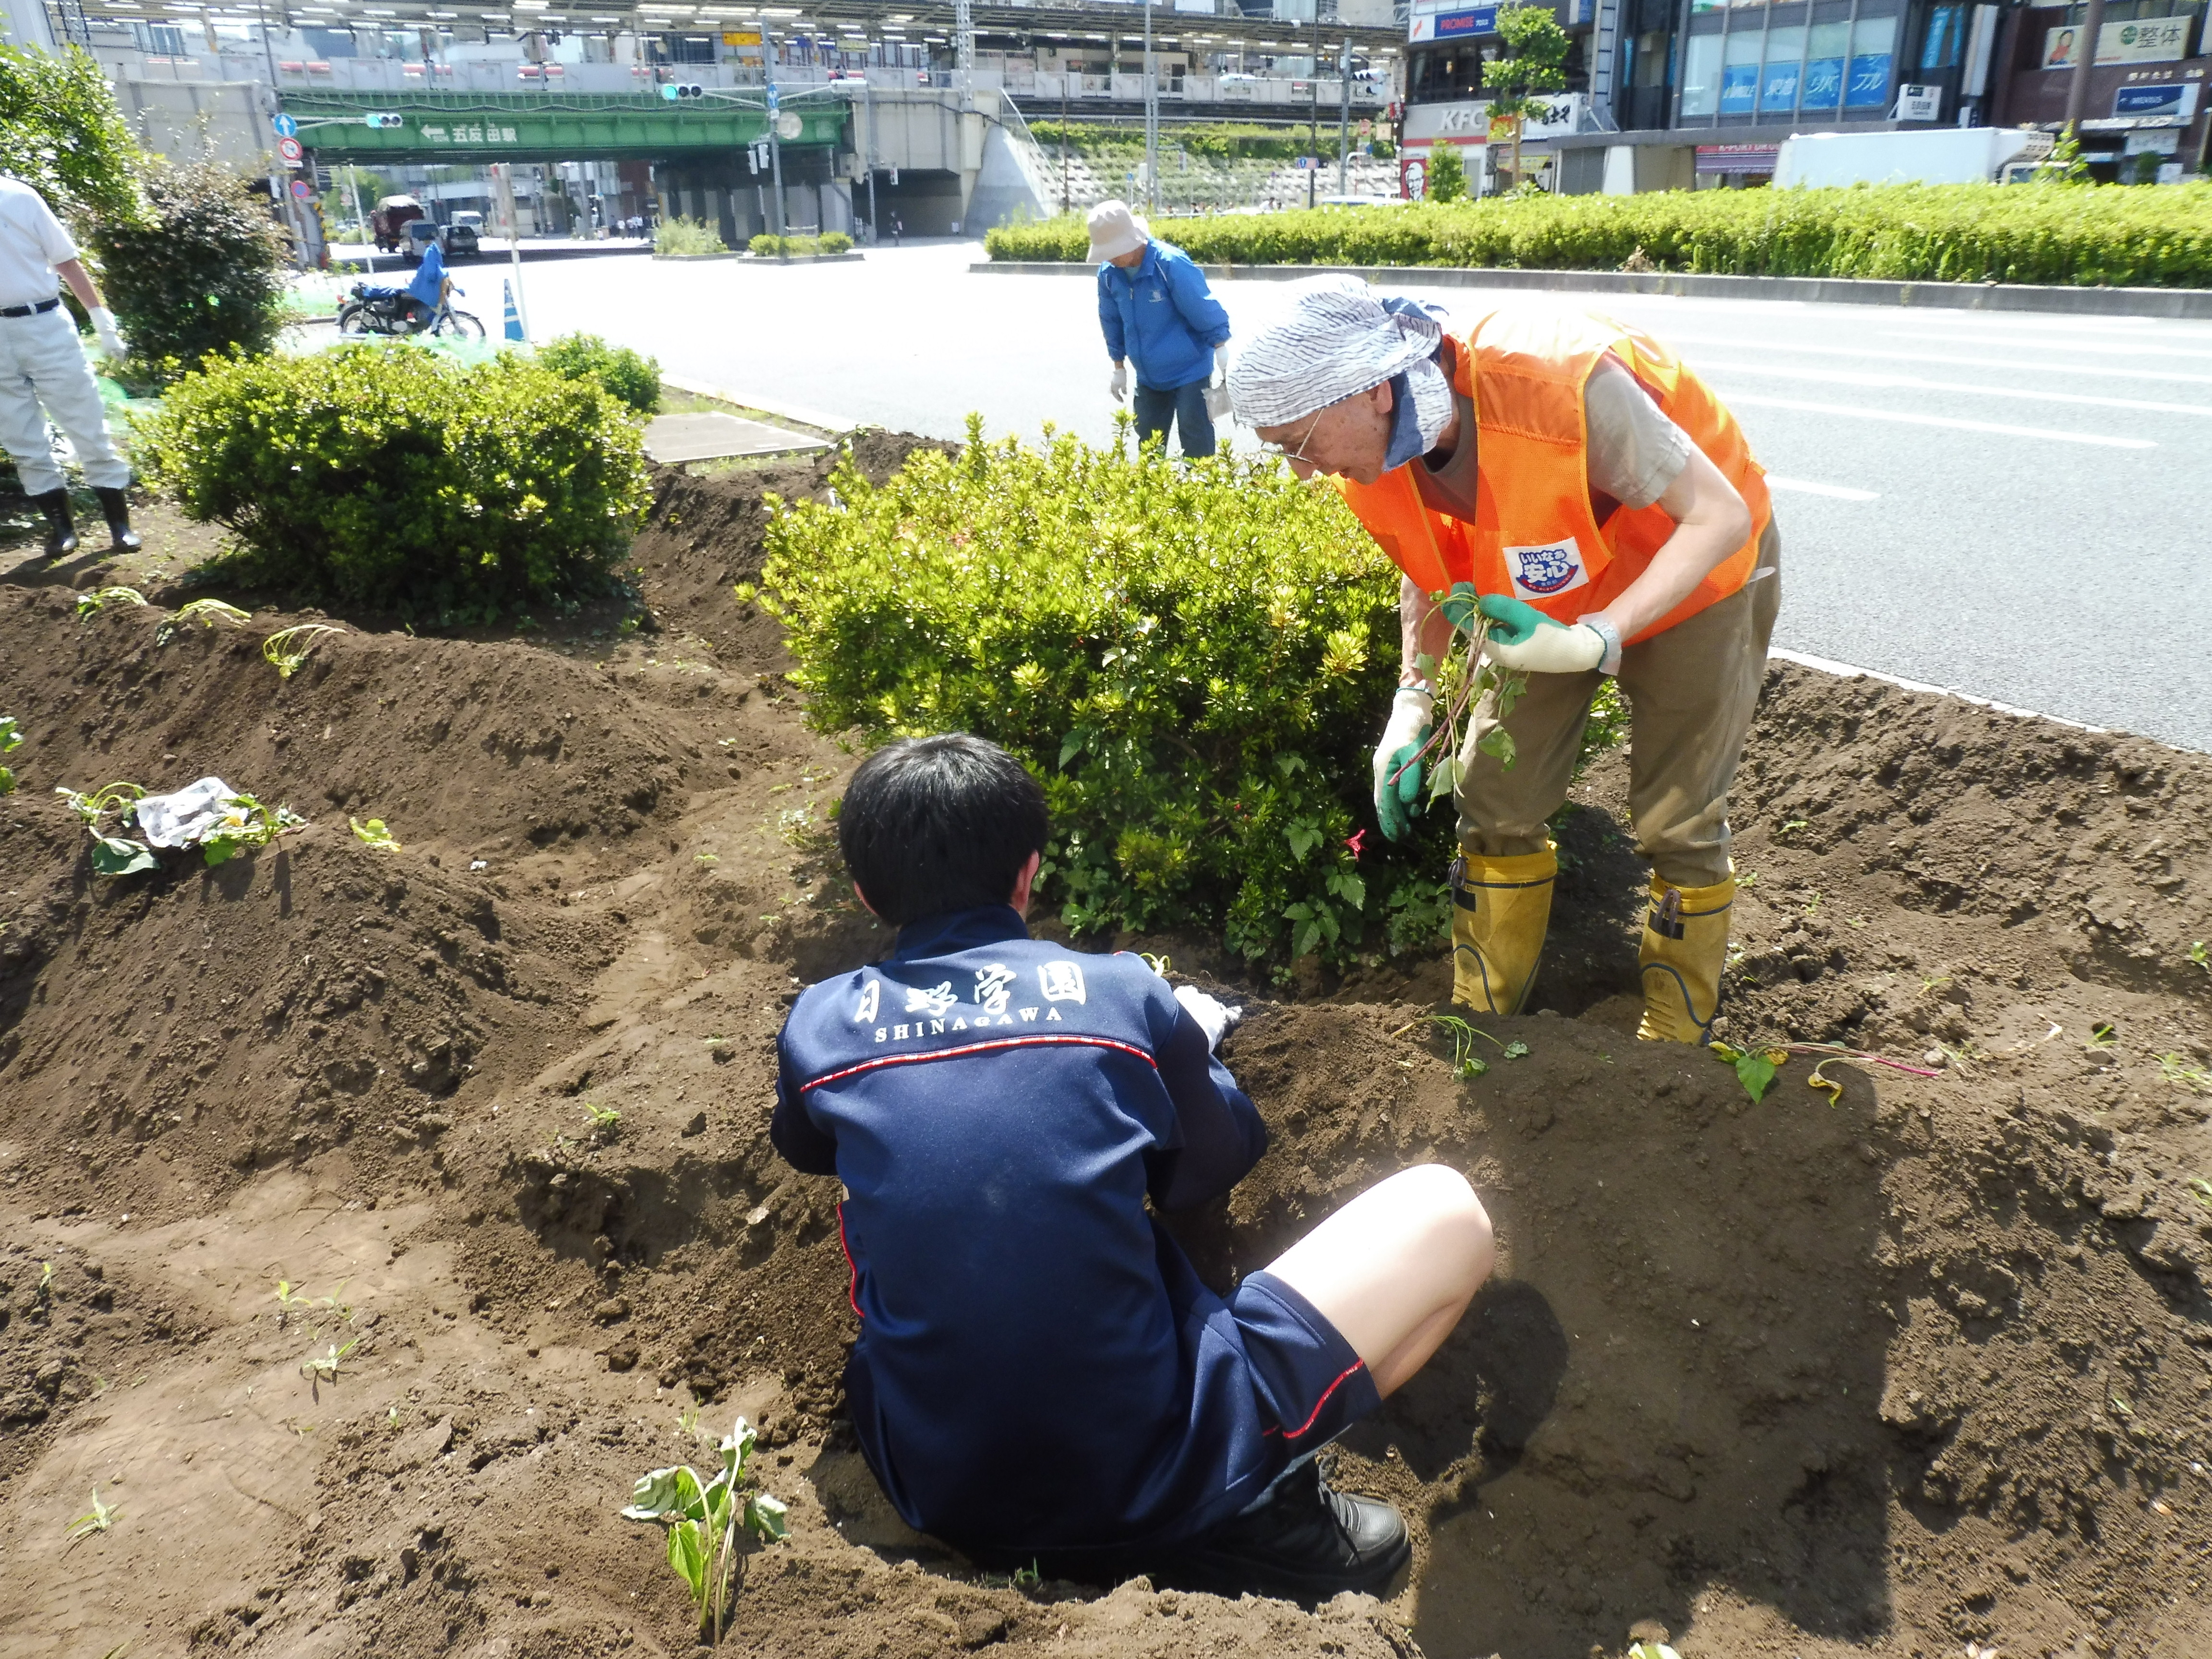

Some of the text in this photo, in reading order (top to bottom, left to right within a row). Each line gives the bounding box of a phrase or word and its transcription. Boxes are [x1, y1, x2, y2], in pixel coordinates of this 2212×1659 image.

[1441, 16, 1475, 30] PROMISE
[2137, 24, 2182, 48] 整体
[1440, 108, 1486, 132] KFC
[452, 128, 517, 142] 五反田駅
[1524, 561, 1568, 583] 安心
[875, 1007, 1062, 1043] SHINAGAWA
